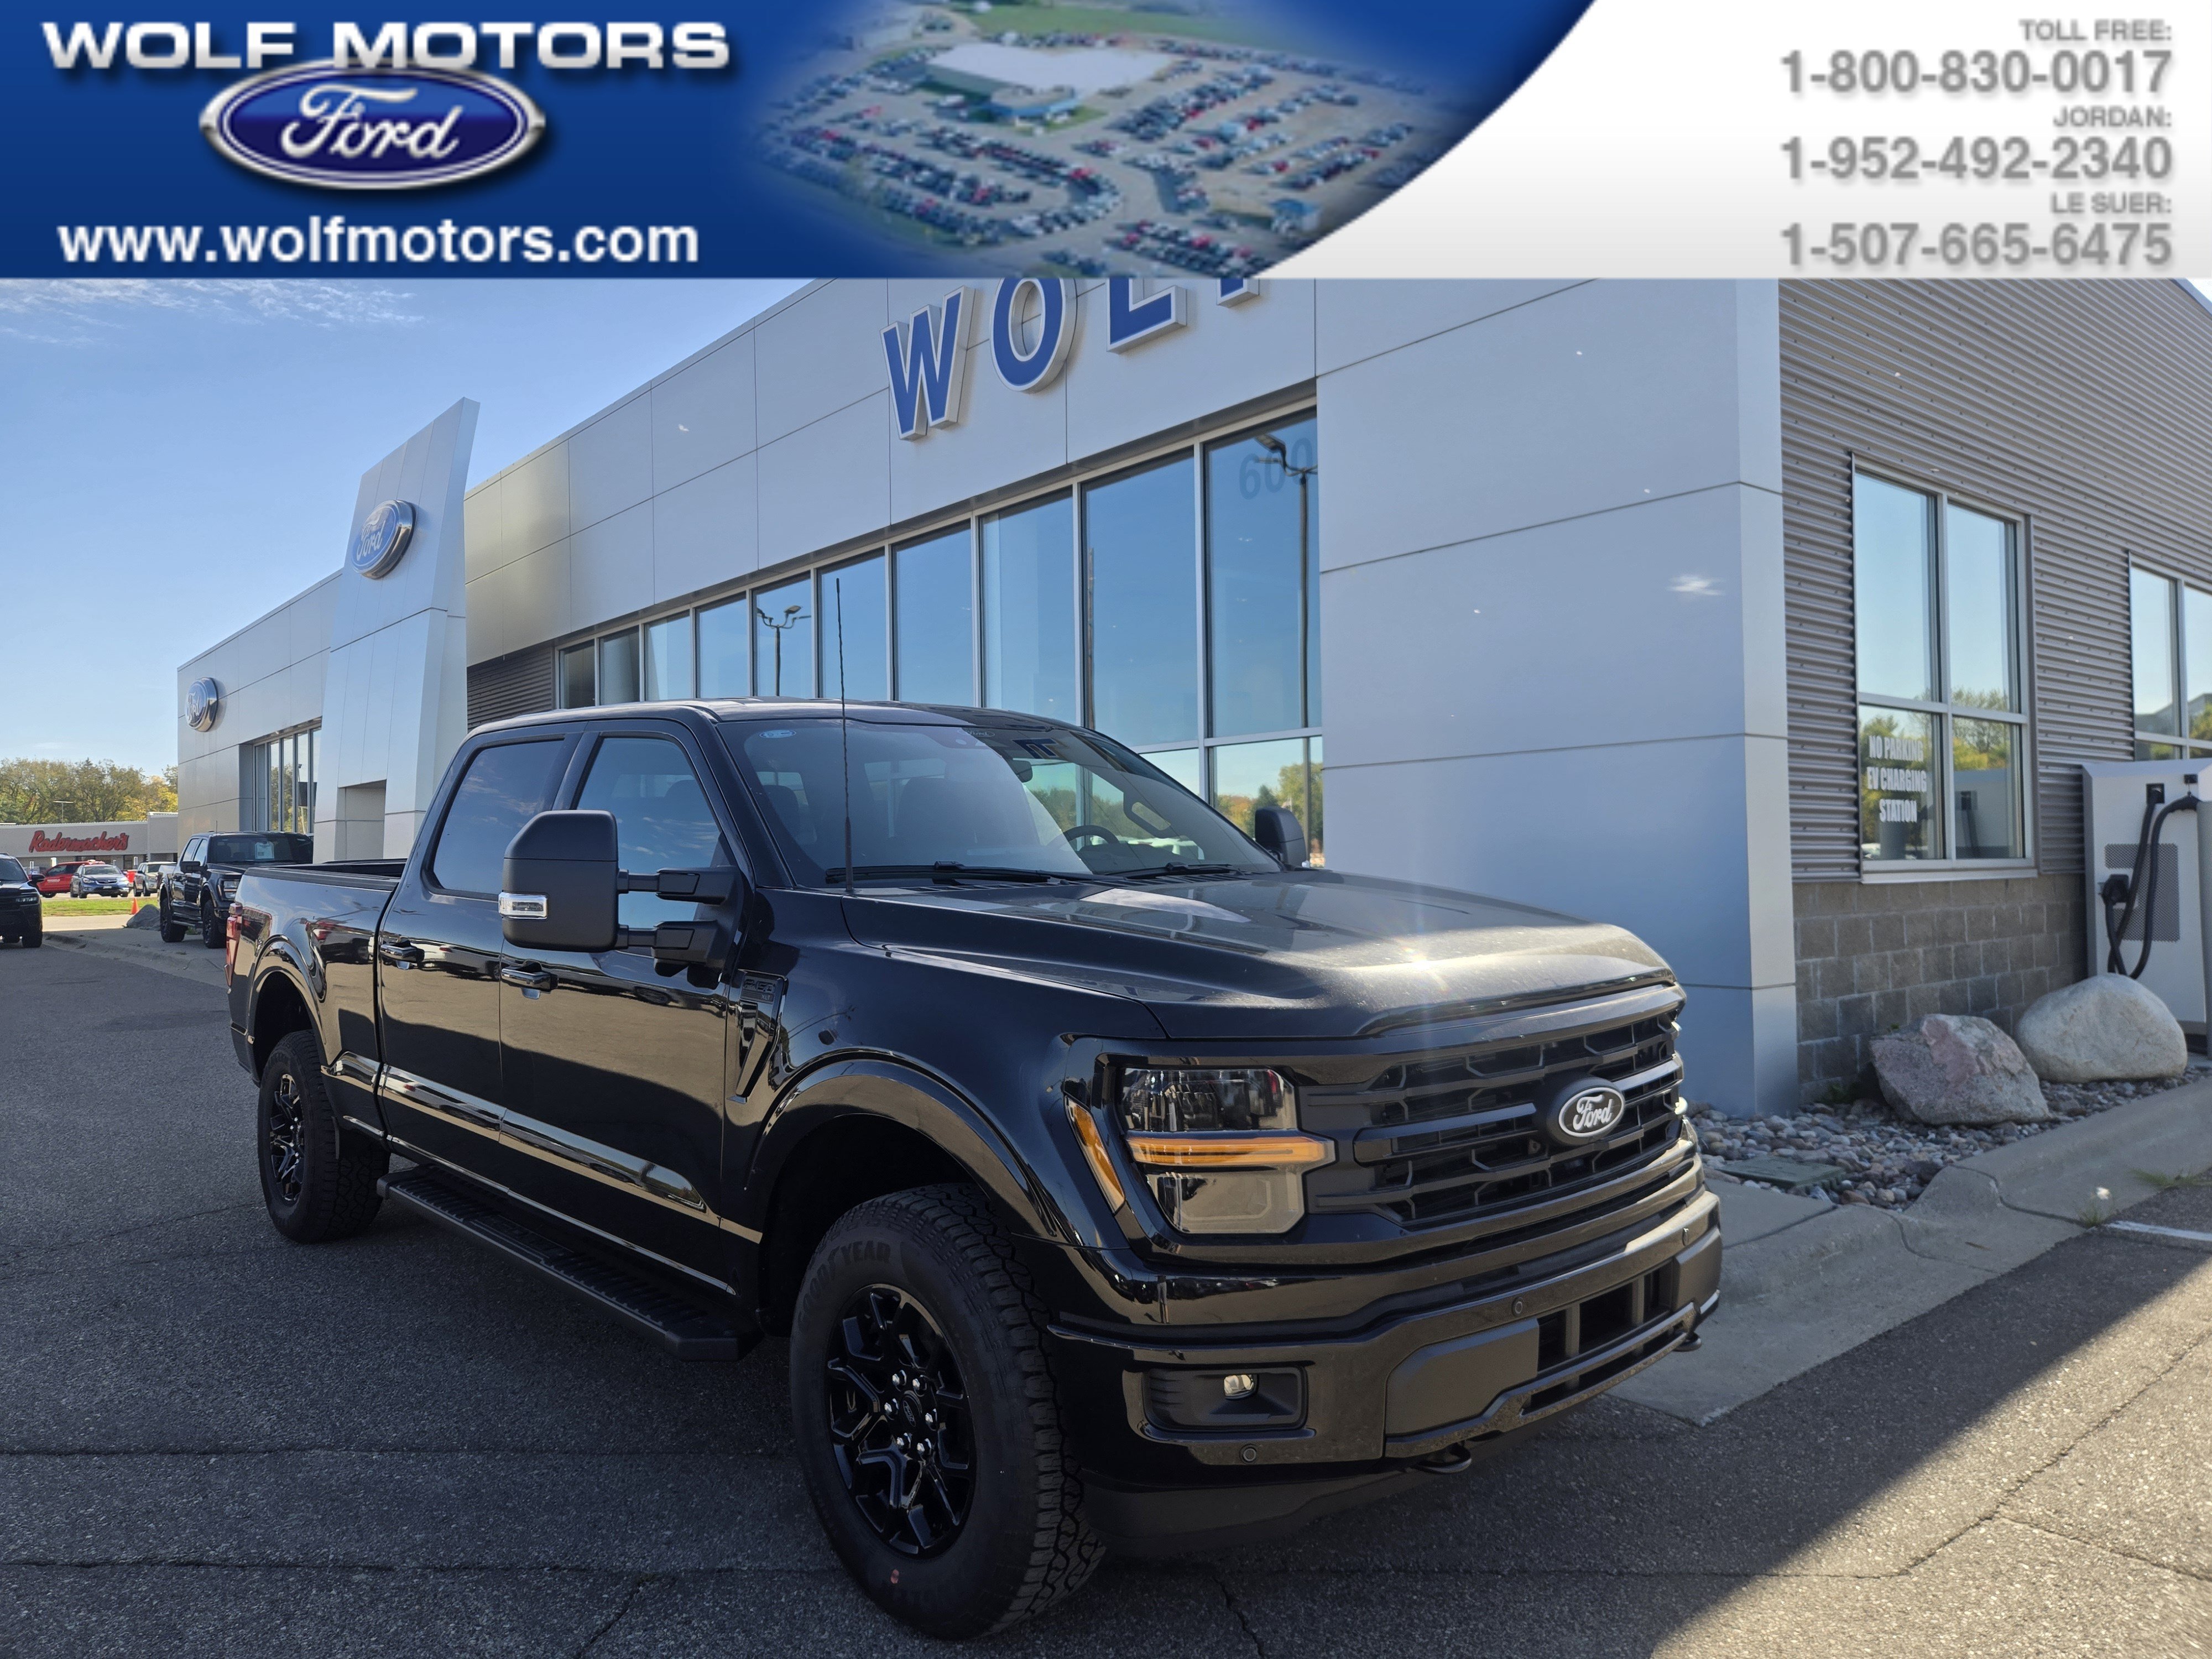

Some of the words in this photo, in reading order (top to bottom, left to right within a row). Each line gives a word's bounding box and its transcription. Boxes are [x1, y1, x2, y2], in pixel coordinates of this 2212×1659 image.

[879, 278, 1260, 440] WOL
[356, 509, 386, 561] Ford
[186, 691, 201, 723] Ford
[1869, 735, 1883, 759] NO
[1884, 737, 1924, 761] PARKING
[1866, 766, 1879, 790] EV
[1880, 768, 1927, 792] CHARGING
[1879, 799, 1918, 823] STATION
[1573, 1094, 1613, 1130] Ford
